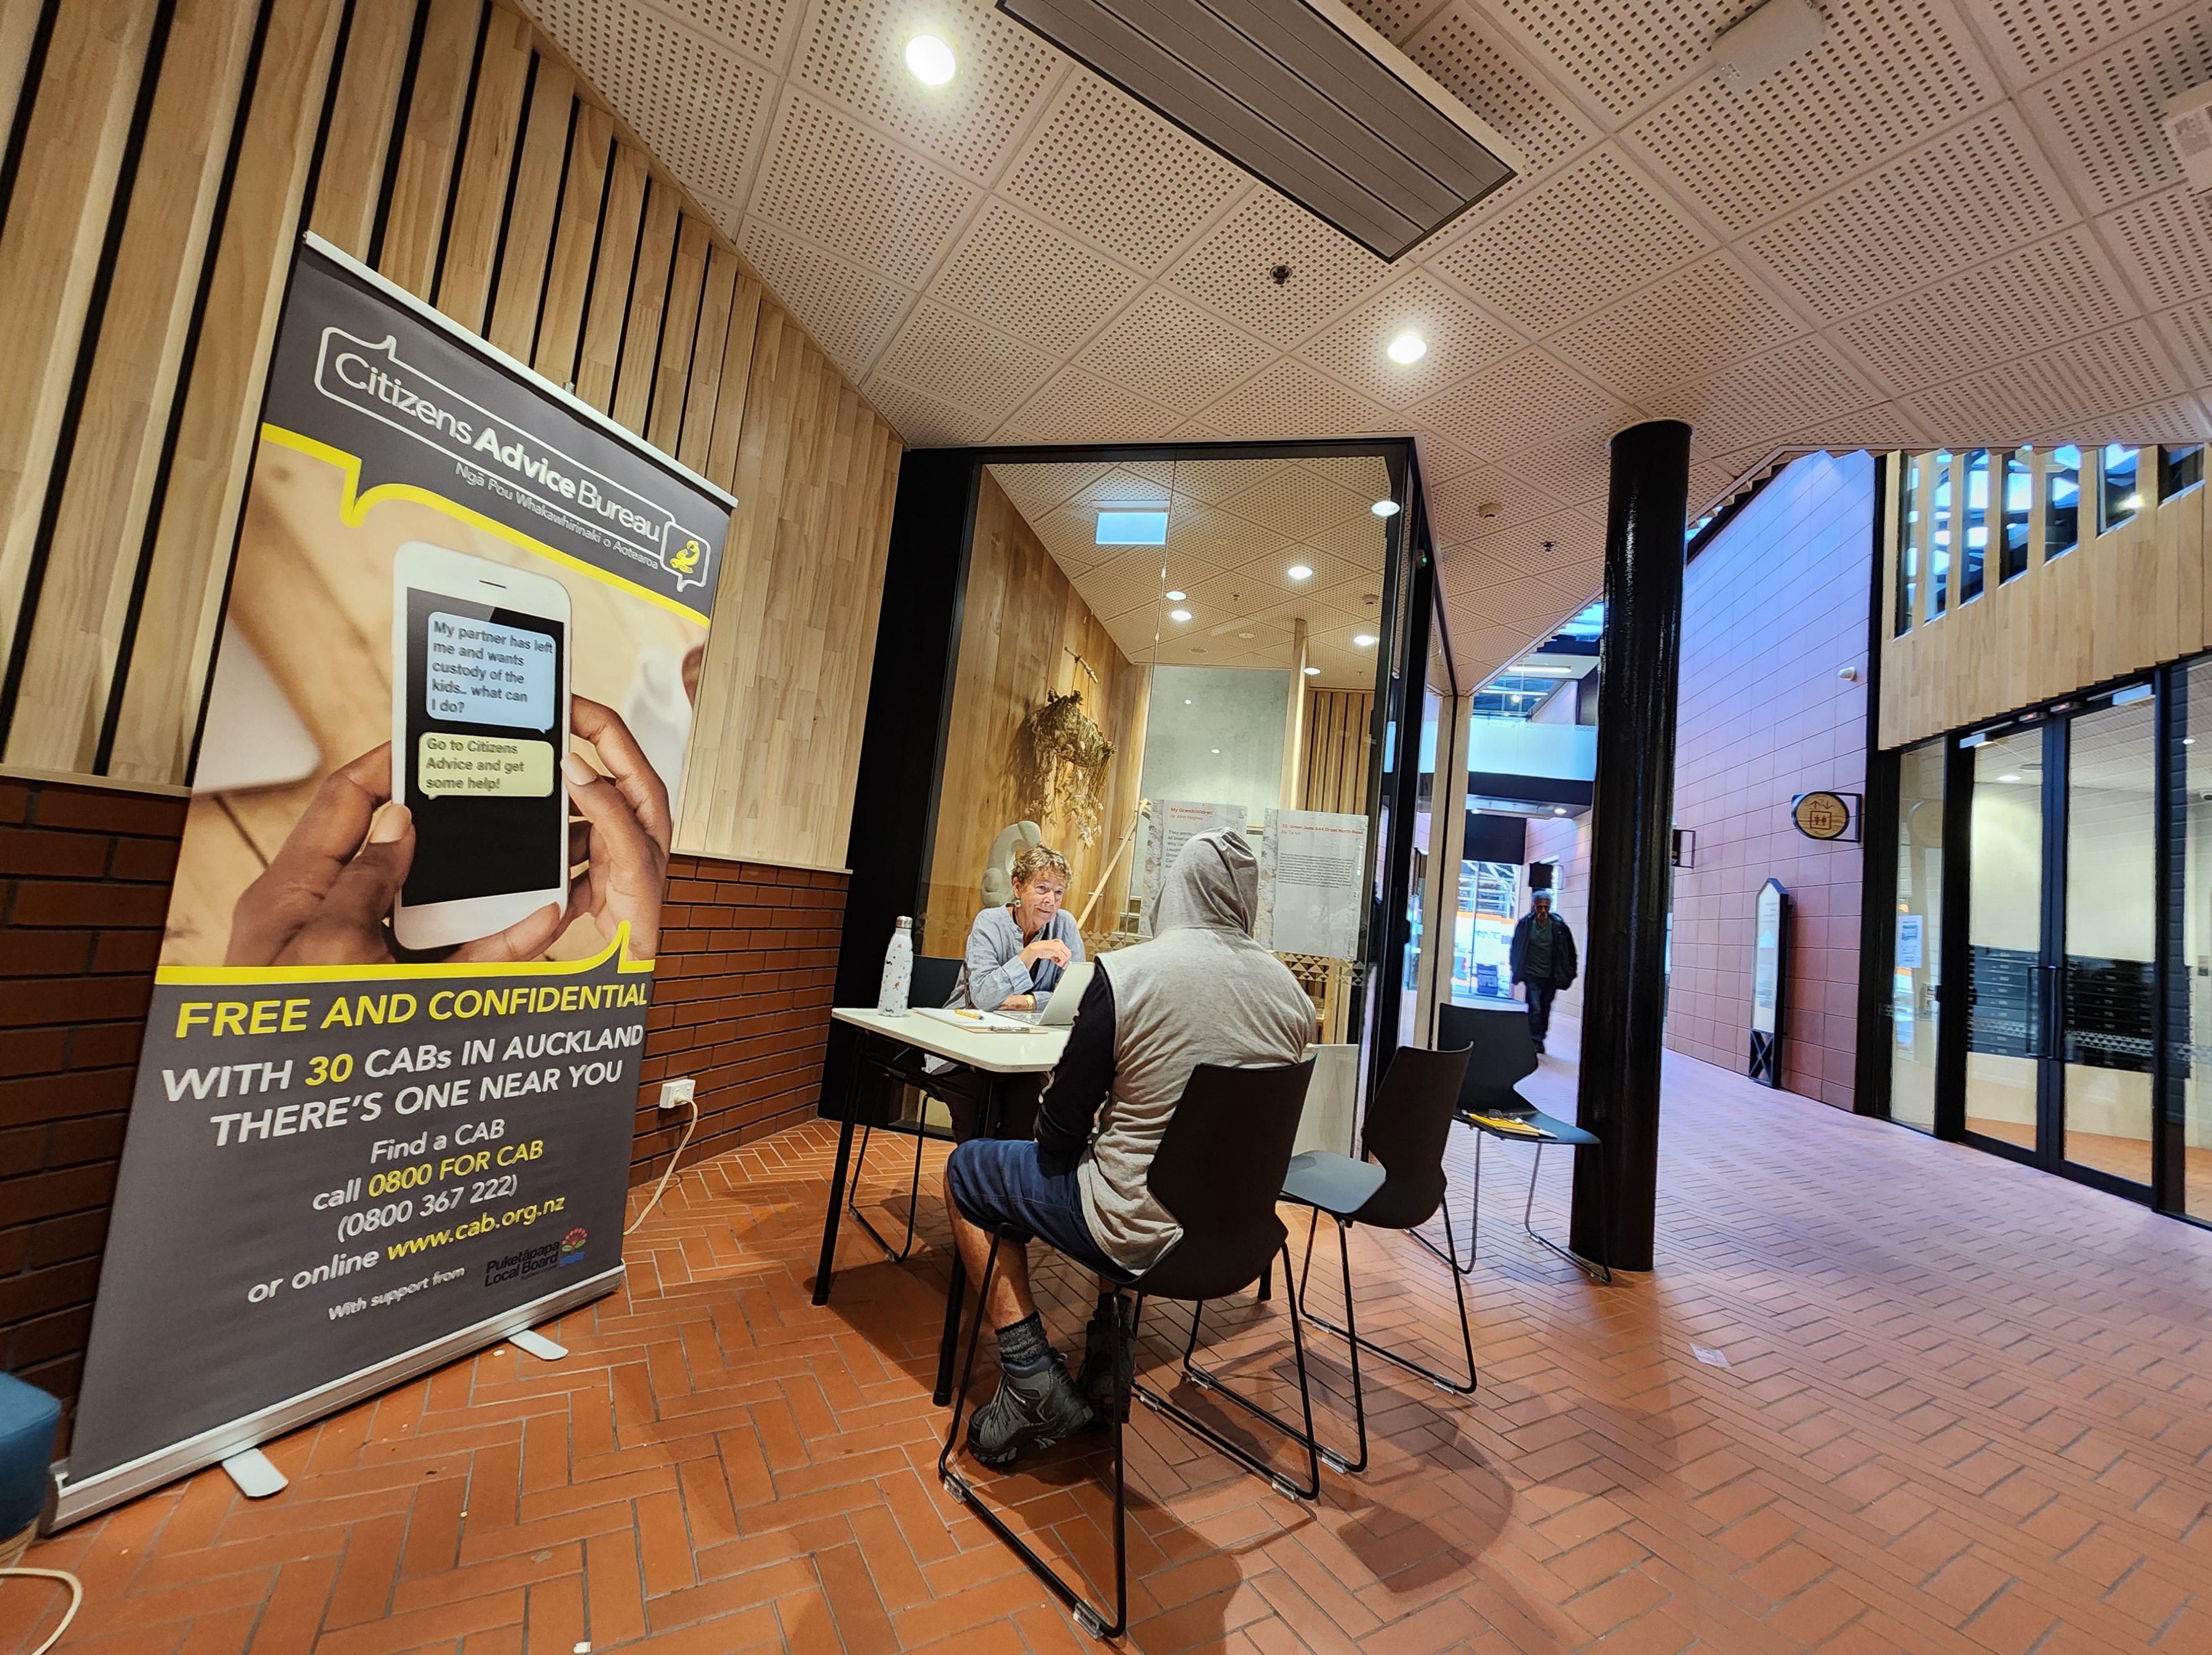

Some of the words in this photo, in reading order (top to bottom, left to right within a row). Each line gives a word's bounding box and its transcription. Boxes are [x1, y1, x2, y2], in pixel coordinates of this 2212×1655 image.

[335, 353, 473, 445] Citizens
[473, 428, 577, 499] Advice
[577, 479, 660, 542] Bureau
[455, 462, 485, 486] Ngā
[488, 478, 513, 500] Pou
[516, 491, 601, 543] Whakawhirinaki
[603, 538, 612, 548] o
[612, 541, 658, 570] Aotearoa
[433, 642, 455, 655] me
[458, 646, 484, 659] and
[487, 650, 525, 666] wants
[434, 620, 455, 638] My
[458, 627, 507, 644] partner
[510, 635, 531, 649] has
[534, 639, 553, 654] left
[432, 662, 487, 681] custody
[489, 669, 503, 681] of
[505, 671, 524, 684] the
[471, 685, 502, 699] what
[505, 691, 528, 702] can
[431, 698, 436, 710] I
[440, 699, 465, 713] do?
[425, 757, 472, 771] Advice
[476, 759, 501, 772] and
[504, 761, 524, 774] get
[426, 737, 446, 750] Go
[450, 739, 463, 751] to
[467, 740, 518, 754] Citizens
[425, 778, 463, 789] some
[467, 777, 500, 792] help!
[175, 998, 311, 1038] FREE
[320, 993, 417, 1029] AND
[429, 983, 648, 1020] CONFIDENTIAL
[161, 1059, 294, 1102] WITH
[305, 1053, 353, 1086] 30
[364, 1044, 452, 1078] CABs
[461, 1038, 495, 1066] IN
[502, 1024, 644, 1061] AUCKLAND
[210, 1092, 384, 1147] THERE'S
[394, 1079, 471, 1115] ONE
[479, 1068, 561, 1102] NEAR
[569, 1059, 623, 1088] YOU
[370, 1131, 428, 1164] Find
[432, 1134, 447, 1151] a
[455, 1118, 505, 1146] CAB
[312, 1177, 362, 1211] call
[368, 1163, 432, 1198] 0800
[439, 1151, 491, 1180] FOR
[497, 1139, 544, 1167] CAB
[337, 1200, 413, 1243] (0800
[419, 1186, 465, 1217] 367
[469, 1174, 519, 1204] 222)
[247, 1278, 284, 1303] or
[291, 1250, 379, 1289] online
[387, 1196, 567, 1261] www.cab.org.nz
[484, 1264, 520, 1288] Local
[521, 1250, 559, 1274] Board
[328, 1297, 367, 1320] With
[371, 1277, 429, 1306] support
[432, 1267, 465, 1287] from
